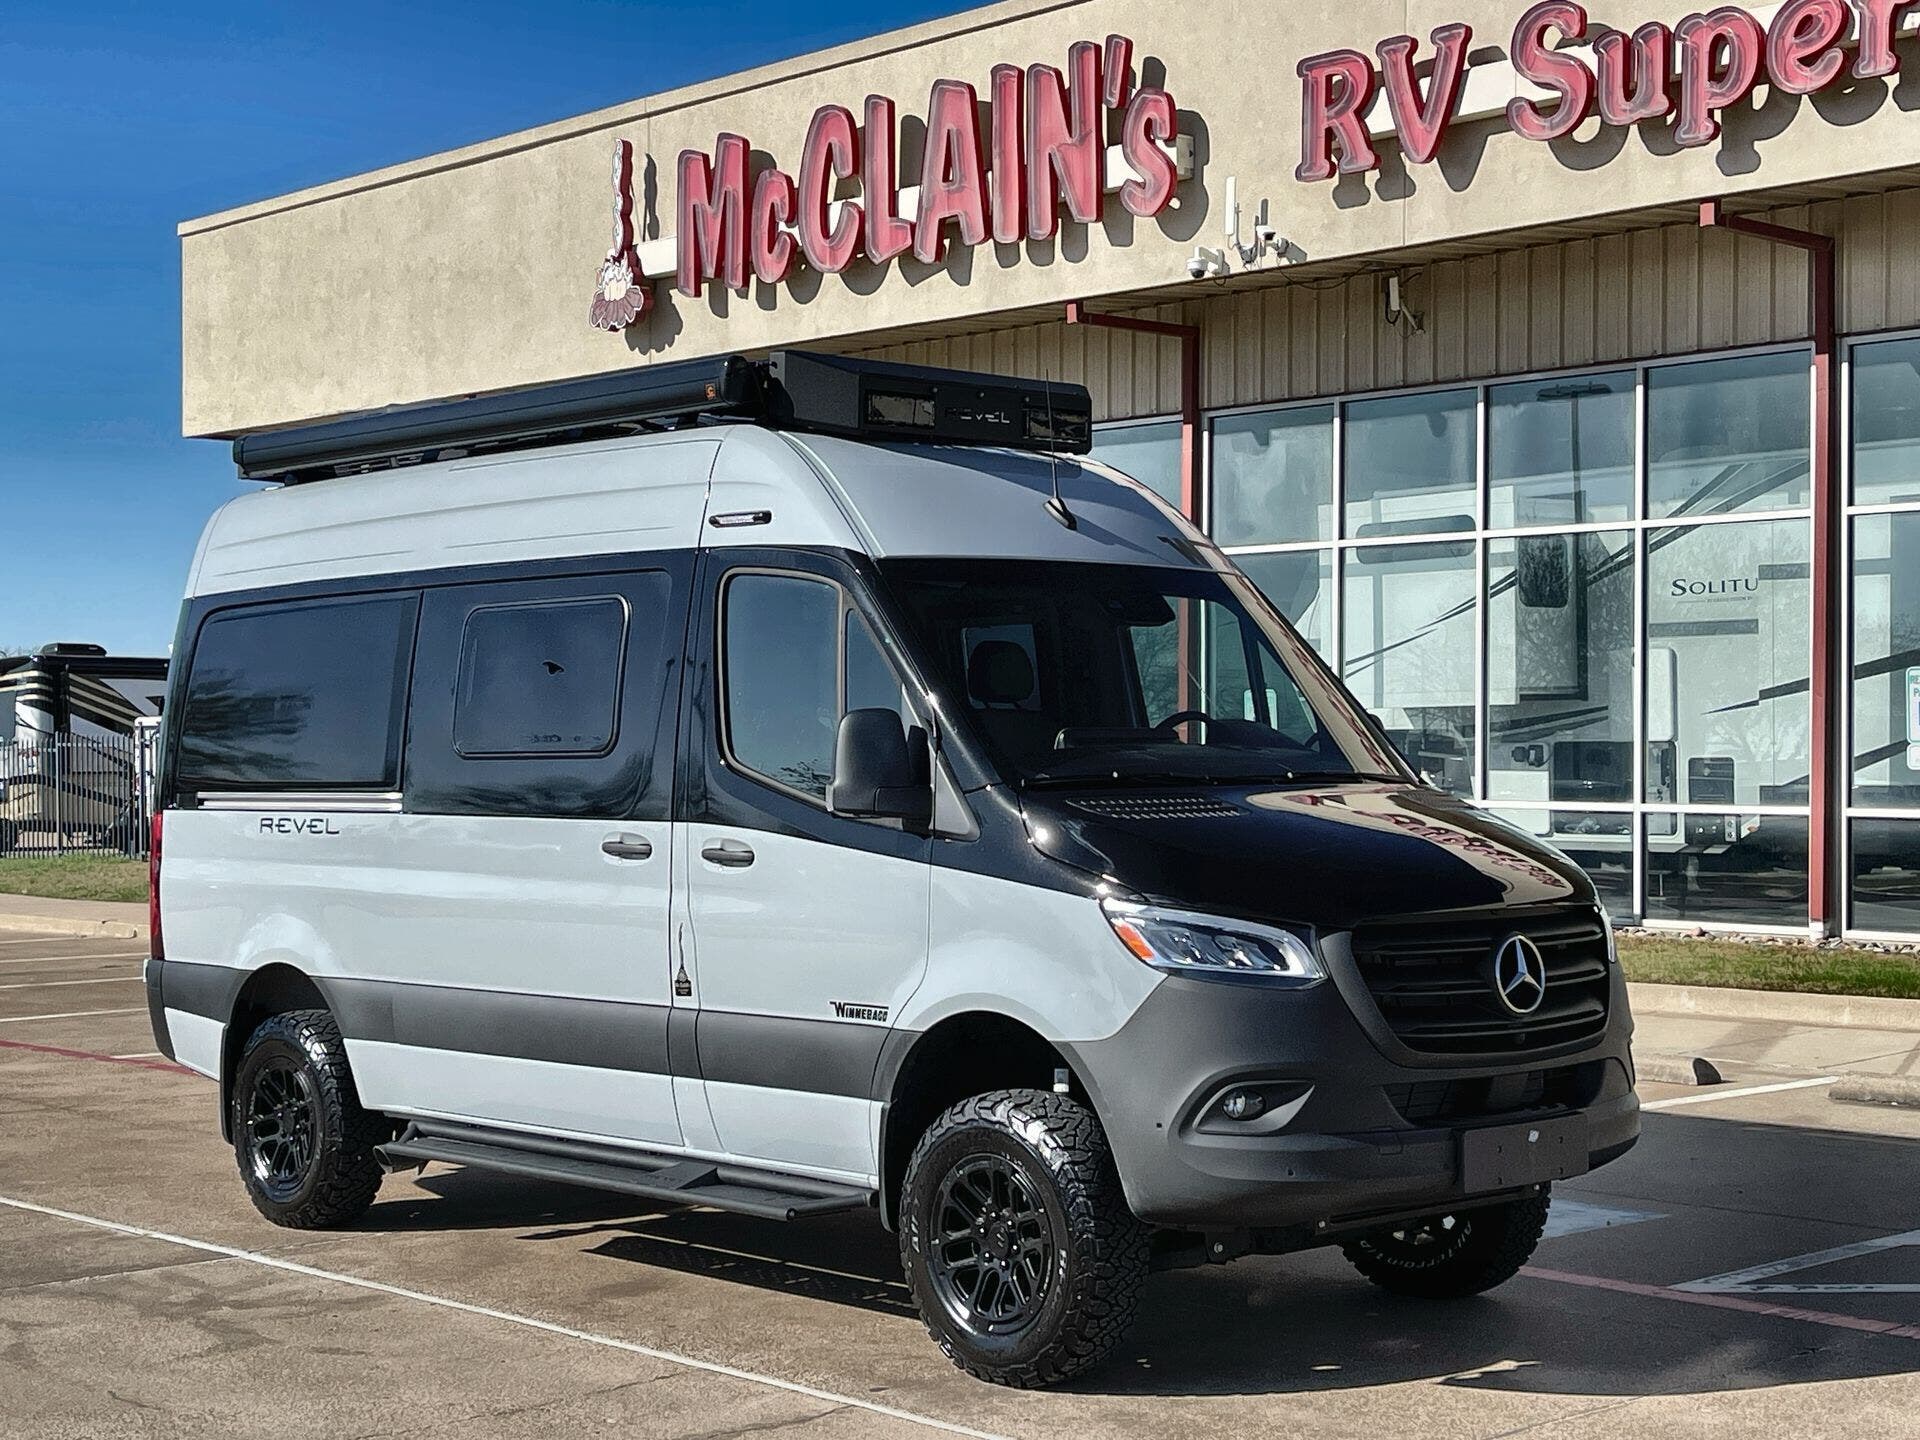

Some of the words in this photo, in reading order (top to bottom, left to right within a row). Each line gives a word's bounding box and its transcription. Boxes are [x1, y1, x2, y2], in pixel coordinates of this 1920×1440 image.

[1295, 23, 1473, 182] RV
[945, 407, 1011, 424] EVEL
[259, 817, 340, 834] REVEL
